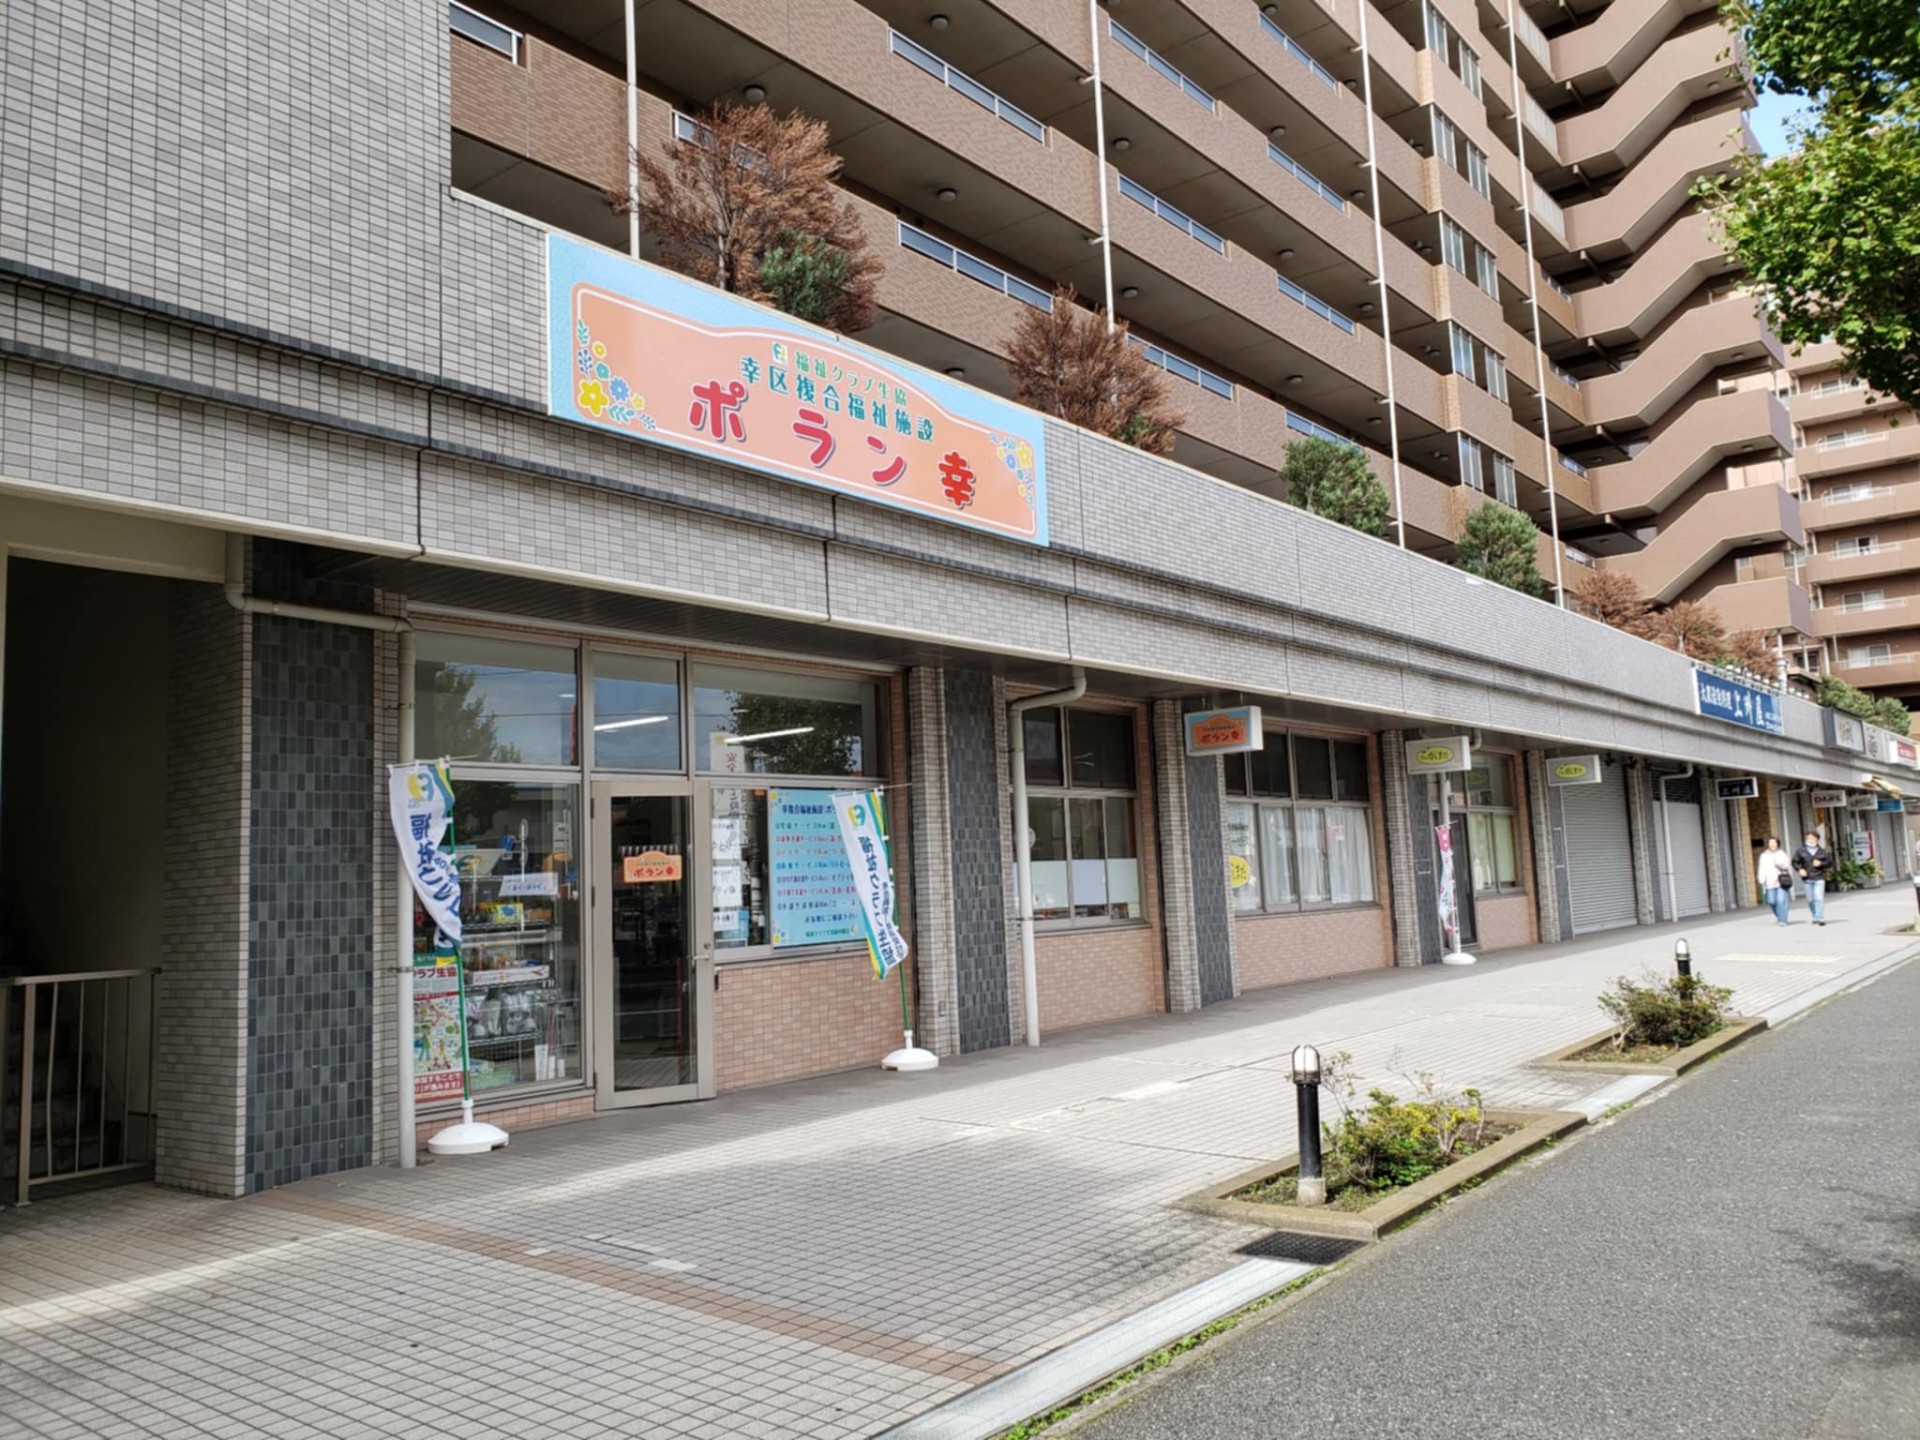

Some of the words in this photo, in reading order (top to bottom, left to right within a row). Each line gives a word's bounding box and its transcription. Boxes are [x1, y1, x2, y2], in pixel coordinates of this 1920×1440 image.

[740, 356, 934, 442] 幸区複合福祉施設
[795, 351, 907, 407] 福祉クラブ生協
[412, 966, 457, 979] ラブ生協
